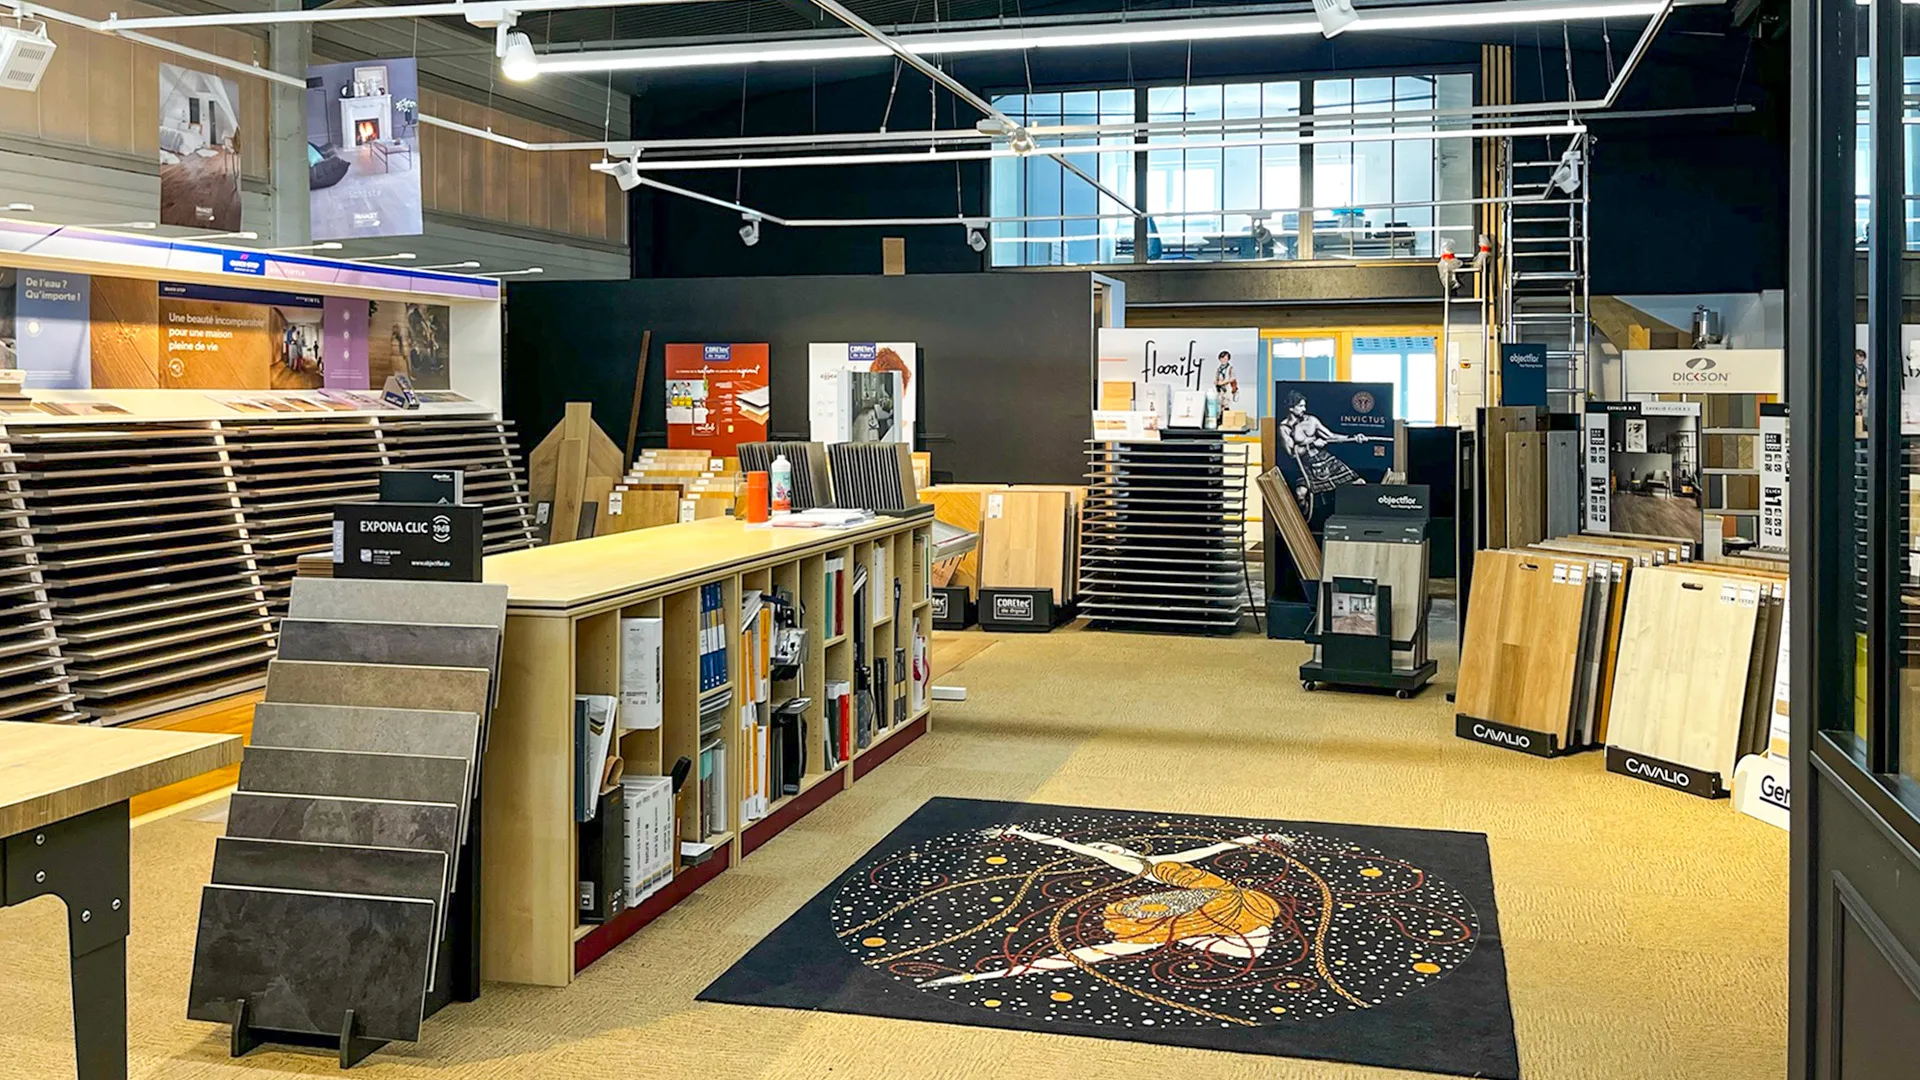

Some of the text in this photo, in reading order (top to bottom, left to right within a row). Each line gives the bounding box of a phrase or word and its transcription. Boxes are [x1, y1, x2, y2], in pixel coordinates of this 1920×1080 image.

[25, 276, 38, 287] De
[40, 278, 61, 289] l'eau
[25, 290, 77, 302] Qu'importe
[168, 312, 265, 328] Une beauté incomparable
[168, 328, 233, 339] pour une maison
[168, 340, 219, 352] pleine de vie
[1141, 340, 1205, 391] floorify
[1673, 372, 1728, 381] DICKSON
[1340, 415, 1385, 424] INVICTUS
[1378, 494, 1416, 505] objectflor
[360, 520, 403, 532] EXPONA
[405, 521, 428, 534] CLIC
[997, 598, 1030, 608] COREtec
[1473, 723, 1531, 748] CAVALIO
[1625, 757, 1690, 788] CAVALIO
